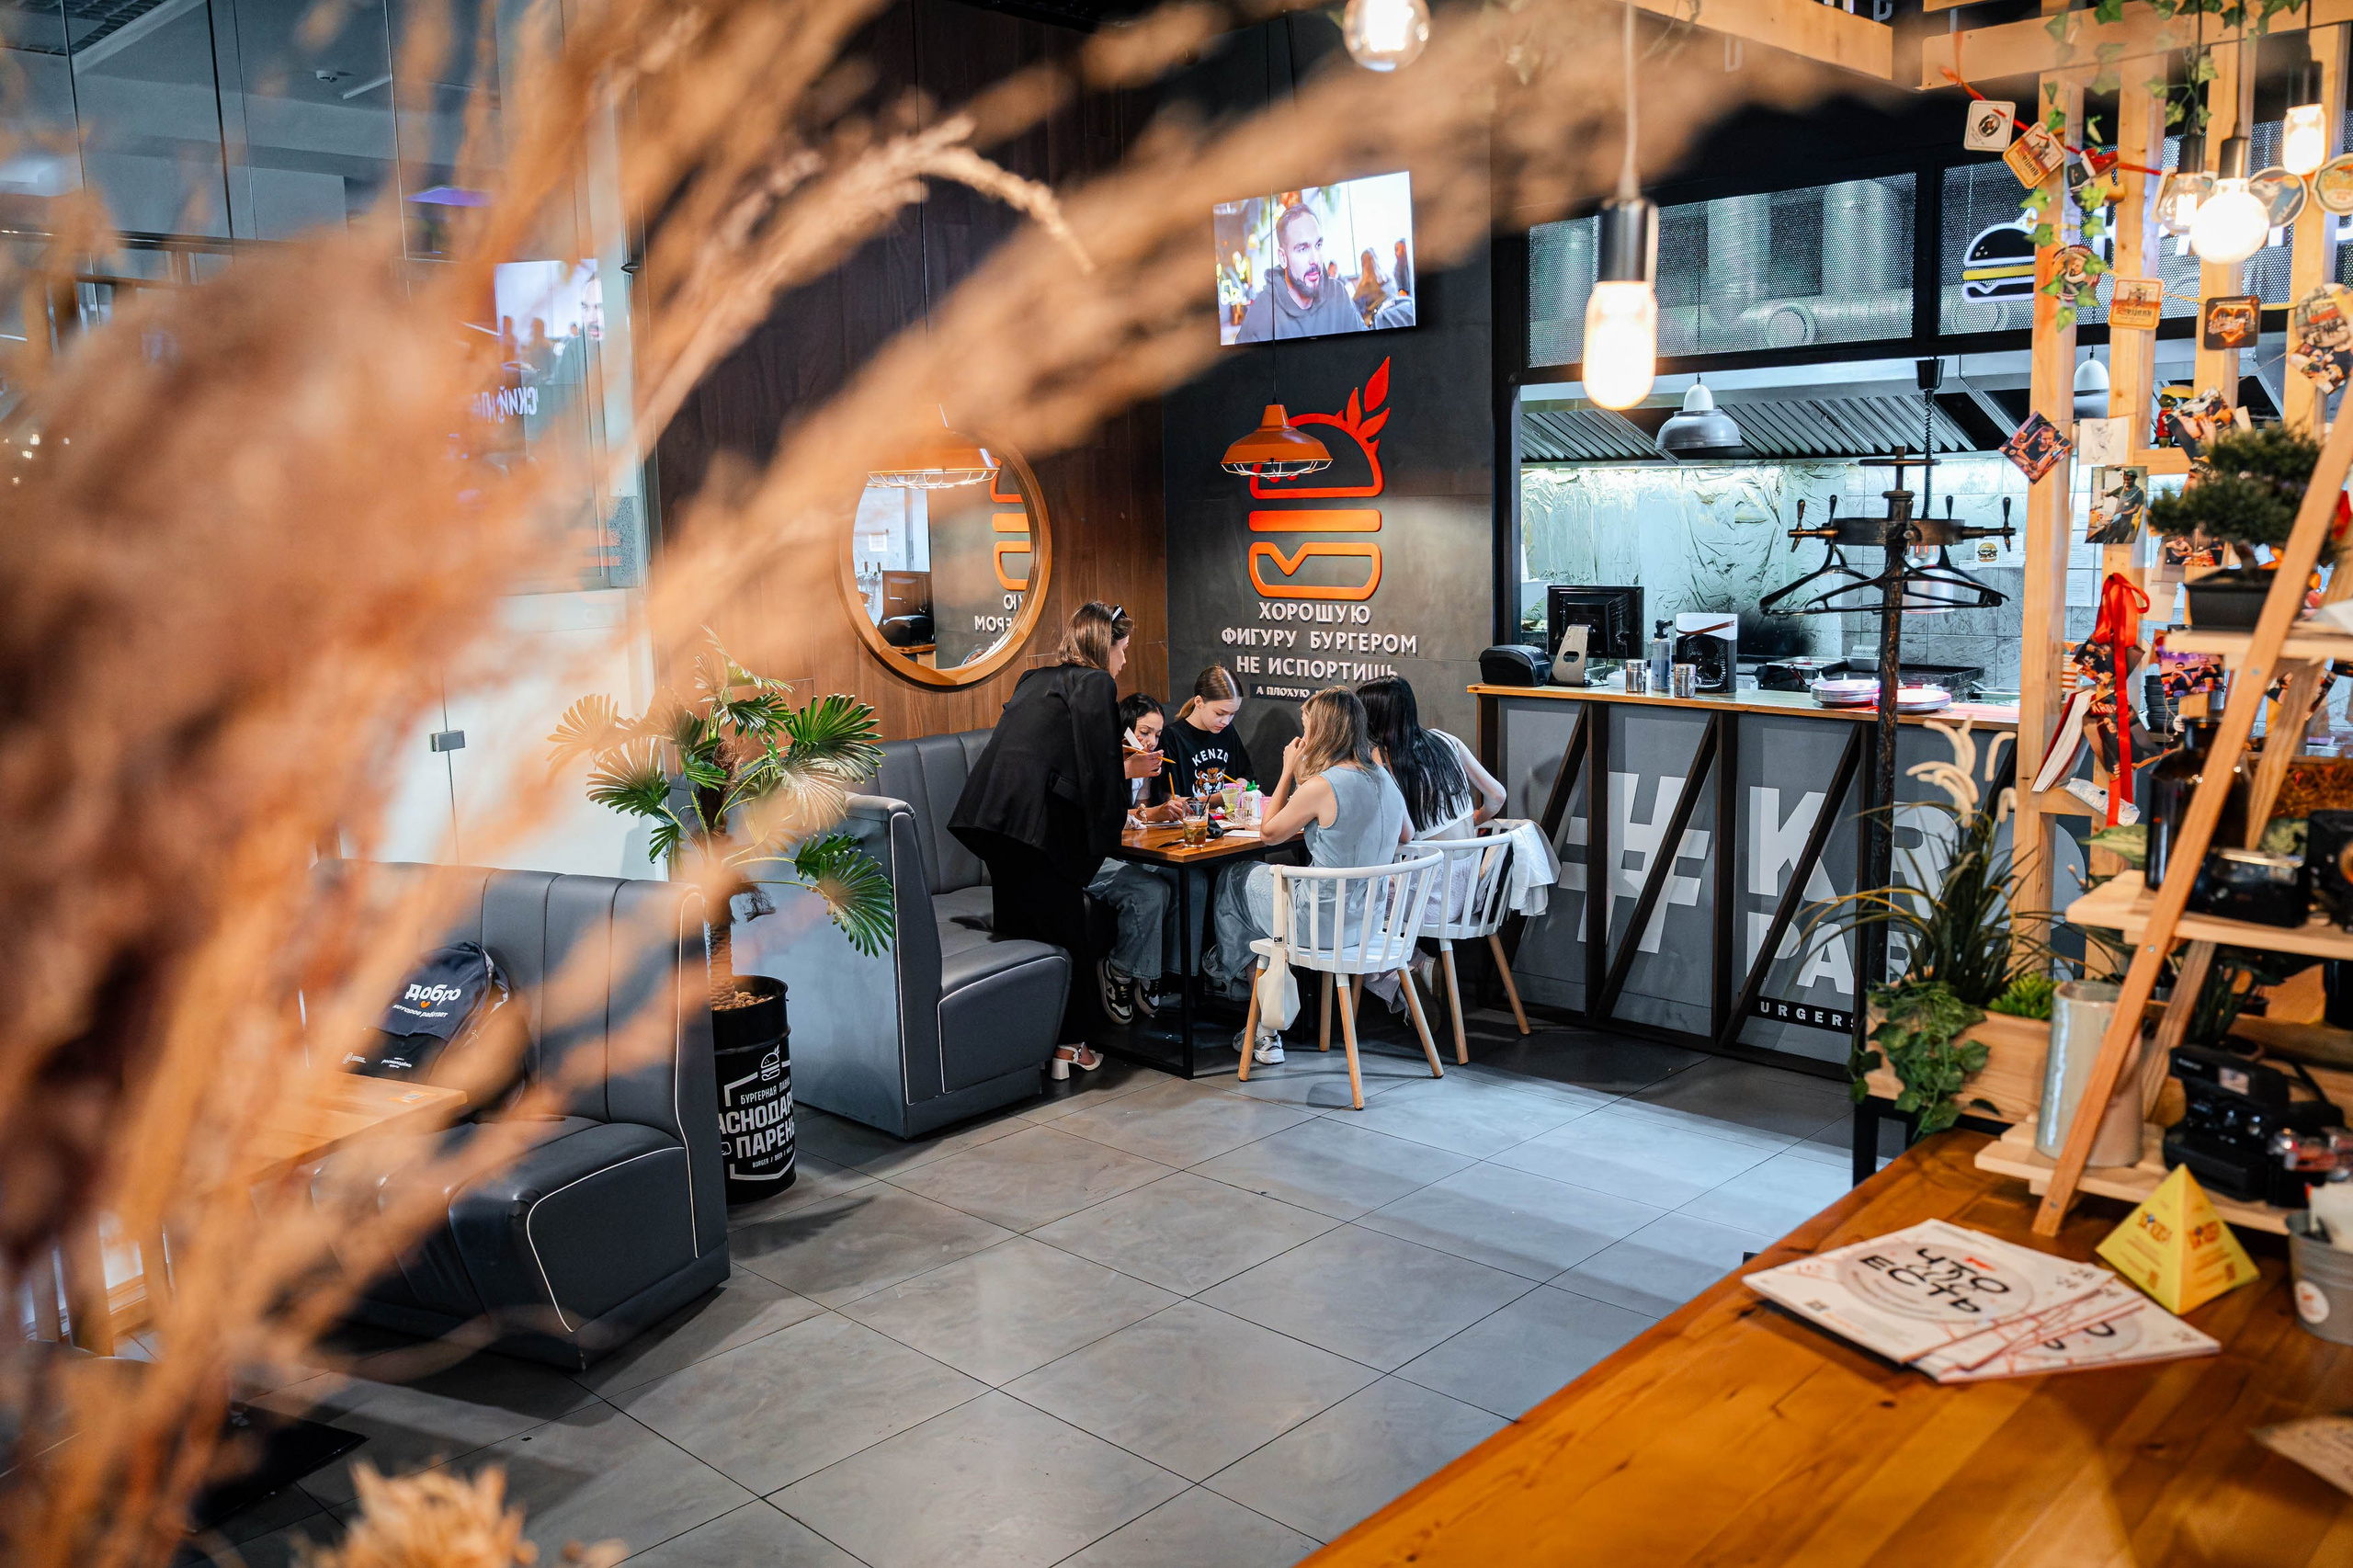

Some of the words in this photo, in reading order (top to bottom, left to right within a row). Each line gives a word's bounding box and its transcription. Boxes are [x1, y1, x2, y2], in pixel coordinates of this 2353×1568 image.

[1258, 601, 1371, 625] ХОРОШУЮ
[1221, 627, 1297, 649] ФИГУРУ
[1310, 631, 1418, 654] БУРГЕРОМ
[1236, 655, 1260, 675] НЕ
[1256, 686, 1264, 696] А
[1267, 687, 1311, 699] ПЛОХУЮ
[1191, 748, 1229, 767] KENZO
[740, 1085, 778, 1105] БУРГЕРНАЯ
